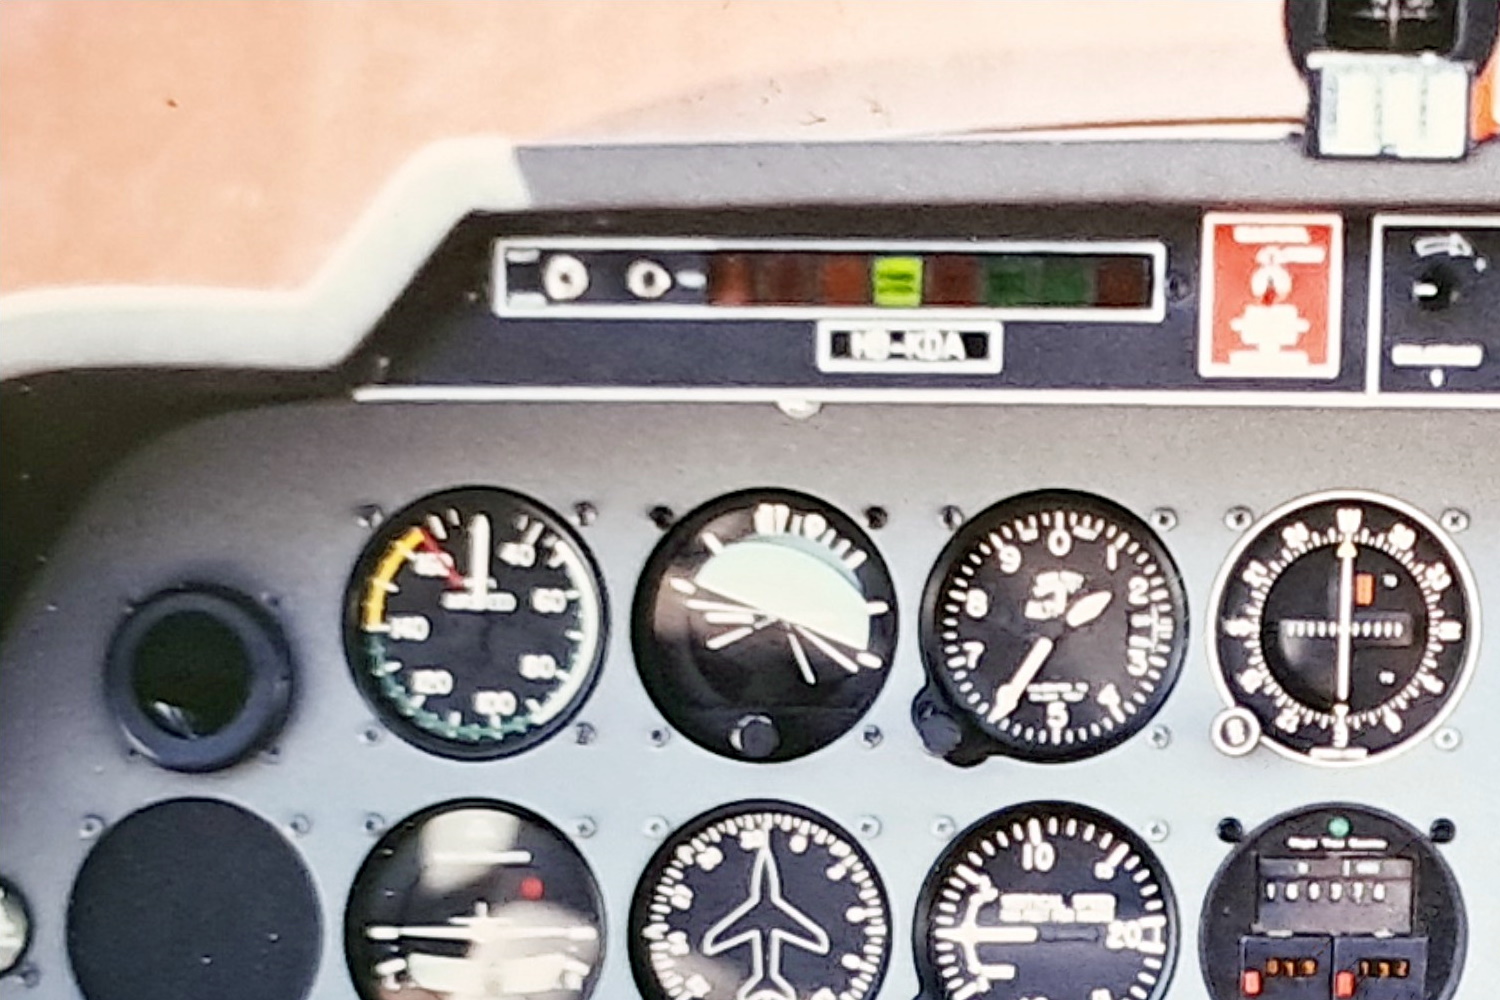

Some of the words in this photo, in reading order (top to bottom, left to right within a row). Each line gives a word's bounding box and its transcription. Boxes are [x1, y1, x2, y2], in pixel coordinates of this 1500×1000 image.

[1048, 529, 1072, 556] 0
[999, 544, 1022, 573] 9
[965, 588, 989, 617] 8
[1128, 576, 1149, 604] 2
[963, 641, 985, 669] 7
[1127, 649, 1148, 676] 3
[1046, 701, 1069, 728] 5
[1022, 842, 1055, 871] 10
